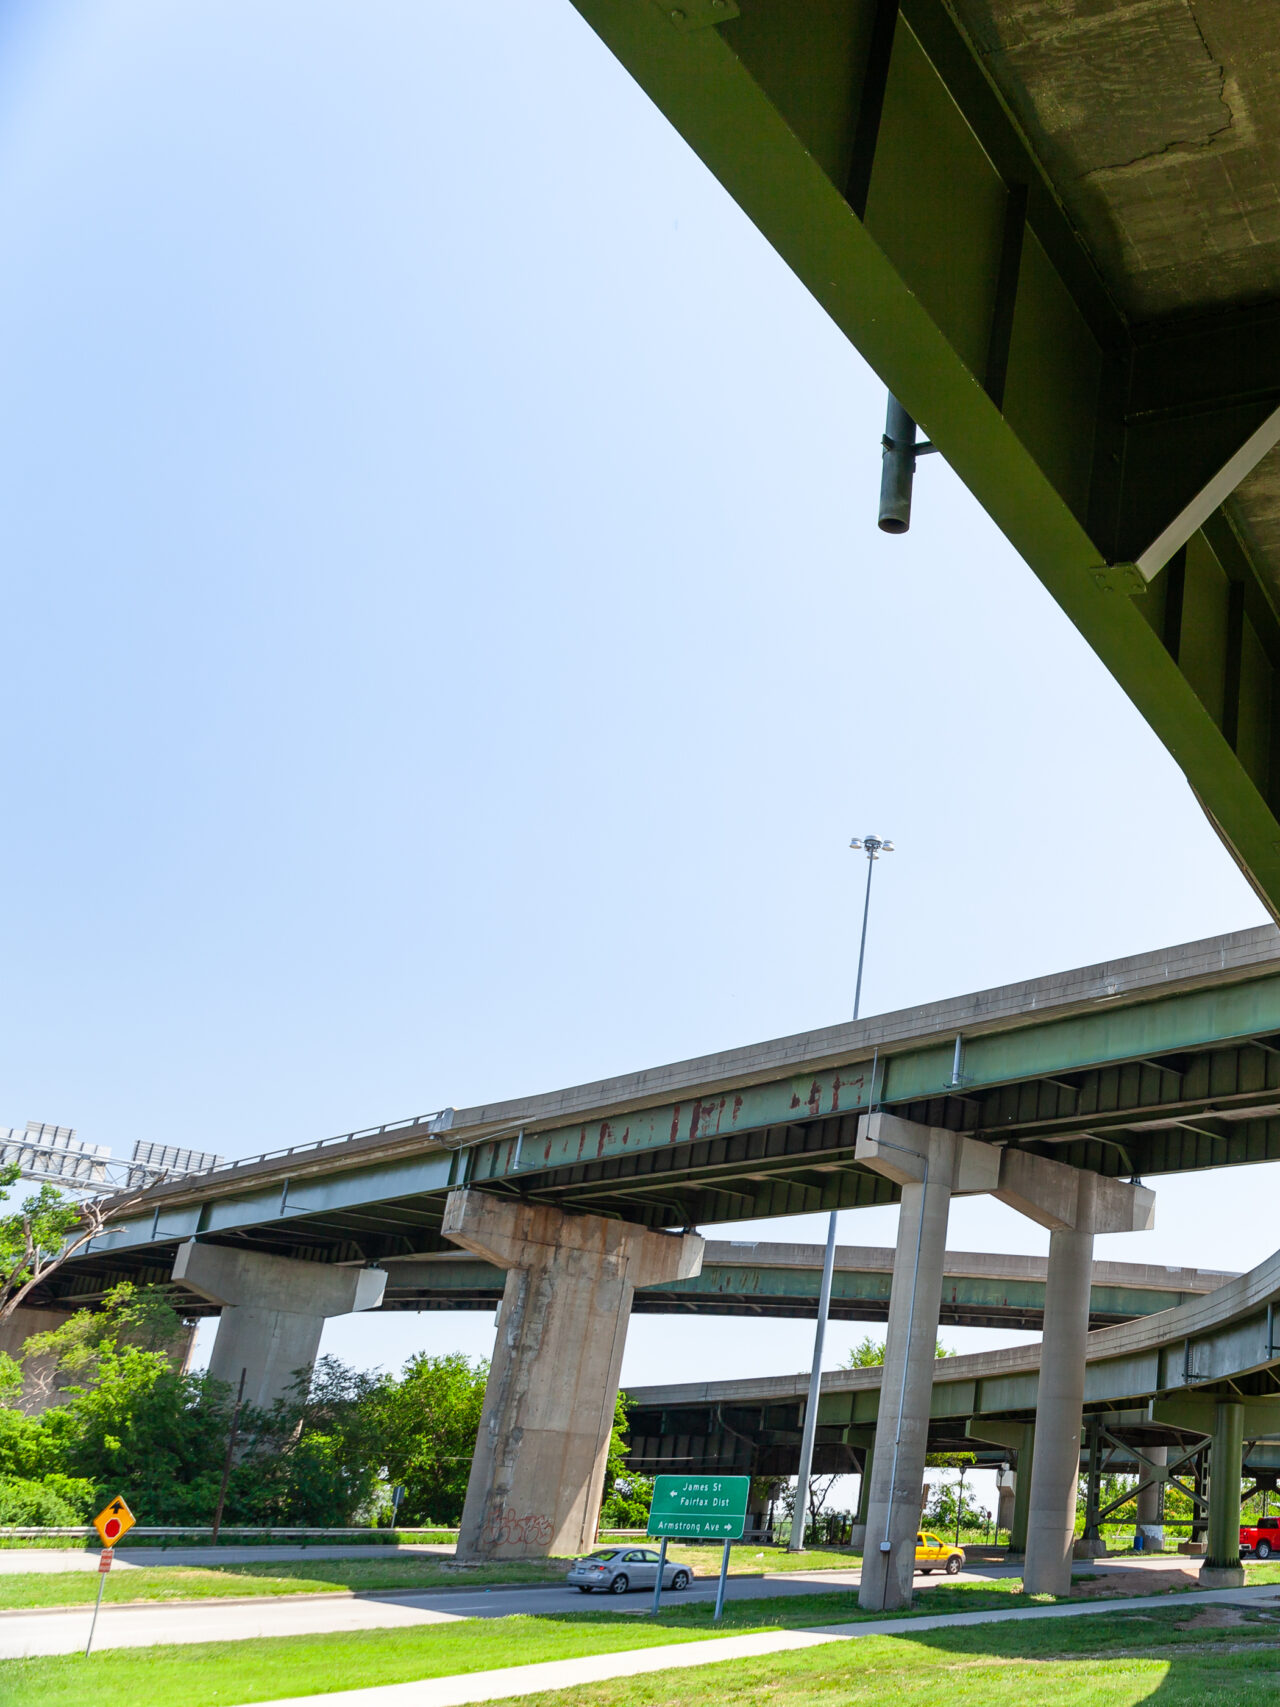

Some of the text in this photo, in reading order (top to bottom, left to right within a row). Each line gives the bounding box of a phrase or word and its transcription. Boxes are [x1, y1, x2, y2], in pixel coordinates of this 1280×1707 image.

[683, 1482, 722, 1491] James St
[680, 1497, 729, 1507] Fairfax Dist
[658, 1521, 720, 1533] Armstrong Ave
